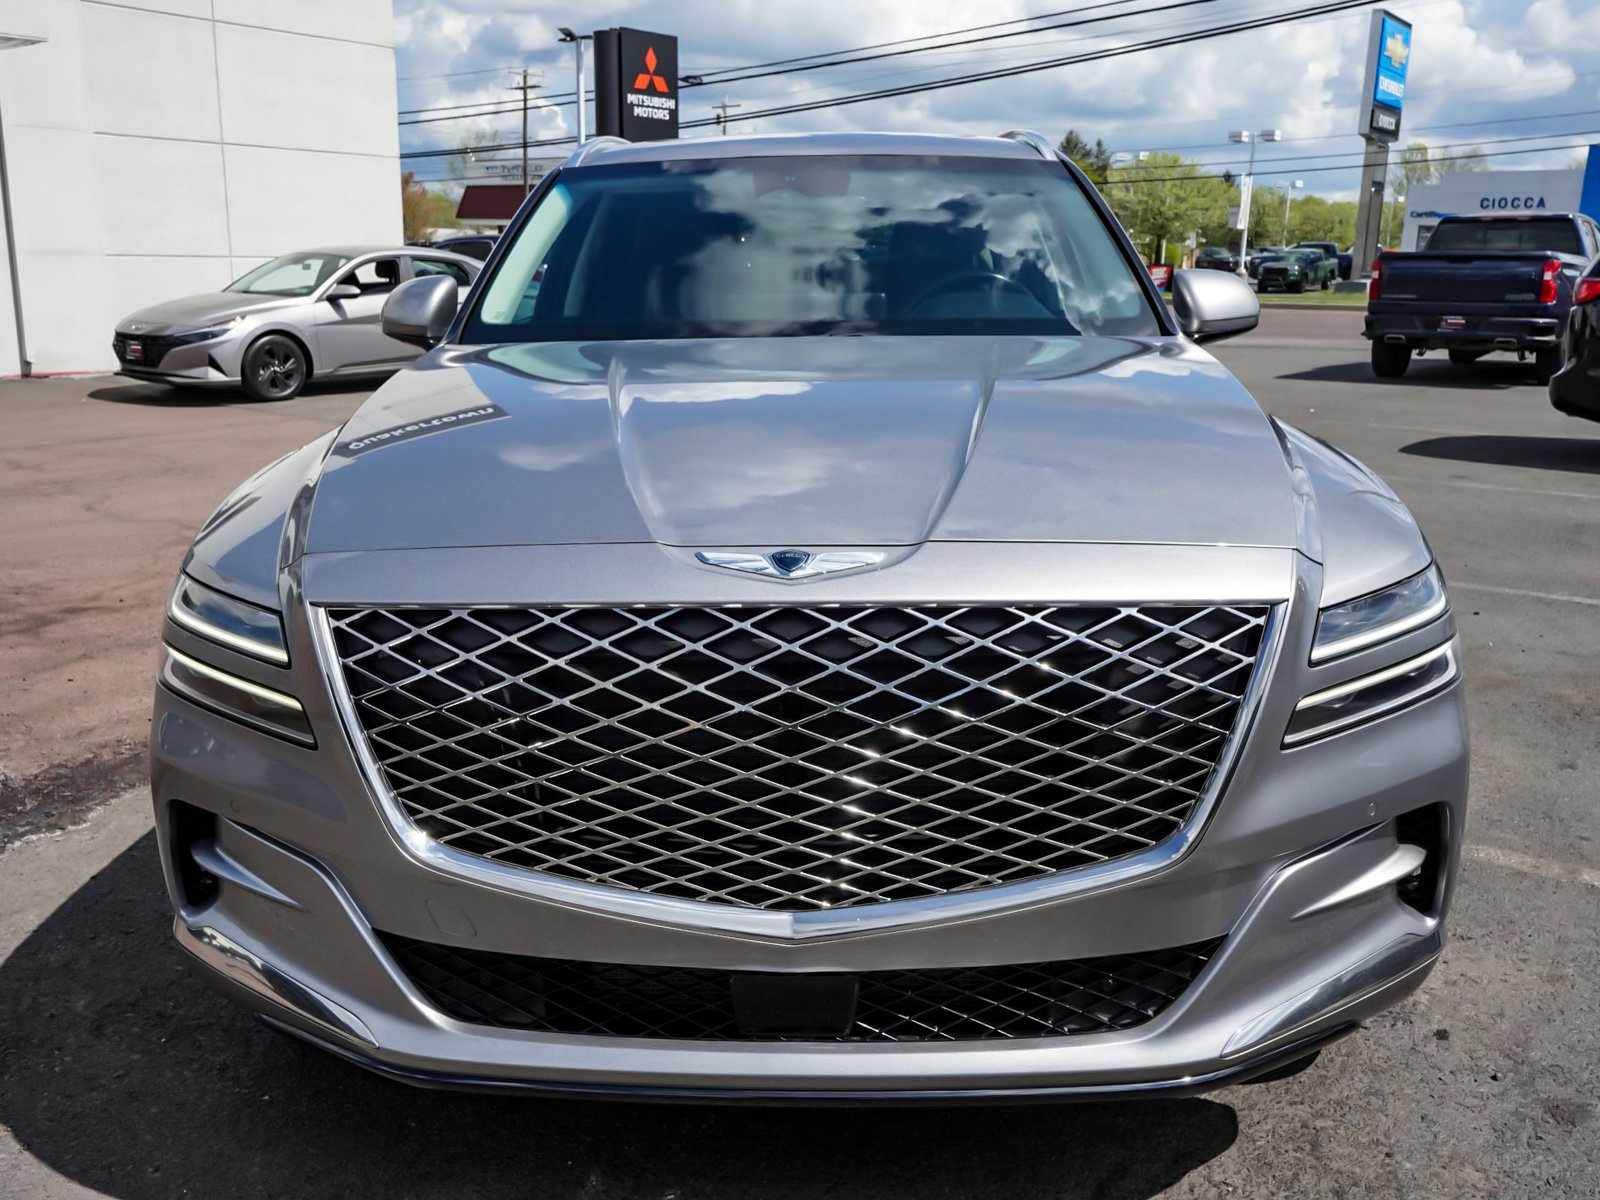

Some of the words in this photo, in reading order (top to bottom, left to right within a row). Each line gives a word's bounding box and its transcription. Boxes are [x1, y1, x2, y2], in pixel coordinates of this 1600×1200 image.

[627, 93, 676, 110] MITSUBISHI
[633, 106, 670, 120] MOTORS
[1480, 196, 1546, 210] CIOCCA
